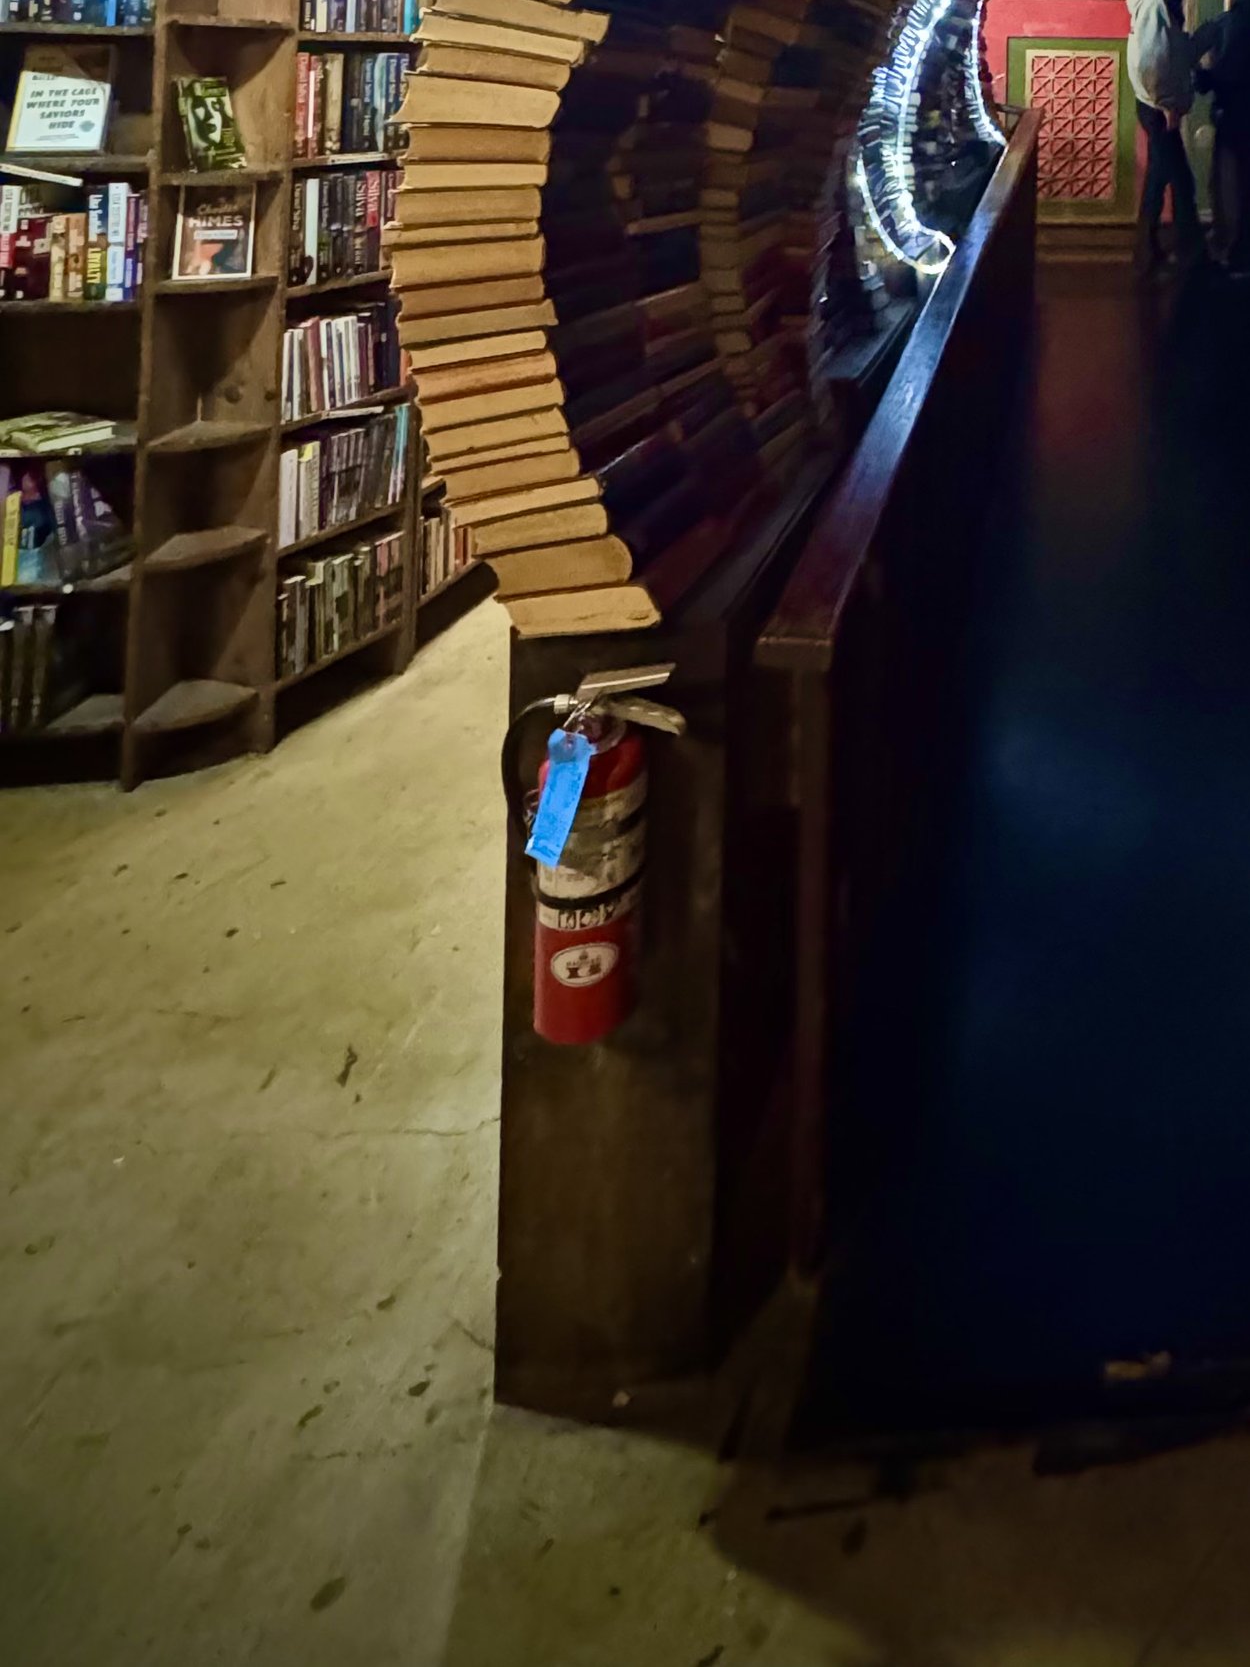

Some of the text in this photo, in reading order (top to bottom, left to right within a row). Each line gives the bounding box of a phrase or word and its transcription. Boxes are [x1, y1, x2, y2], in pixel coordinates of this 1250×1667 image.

[30, 87, 97, 98] IN THE CAGE
[26, 98, 100, 109] WHERE YOUR
[40, 109, 86, 119] SAVIORS
[48, 120, 76, 129] HIDE
[188, 215, 244, 228] HIMES
[86, 247, 102, 284] LOYALTY
